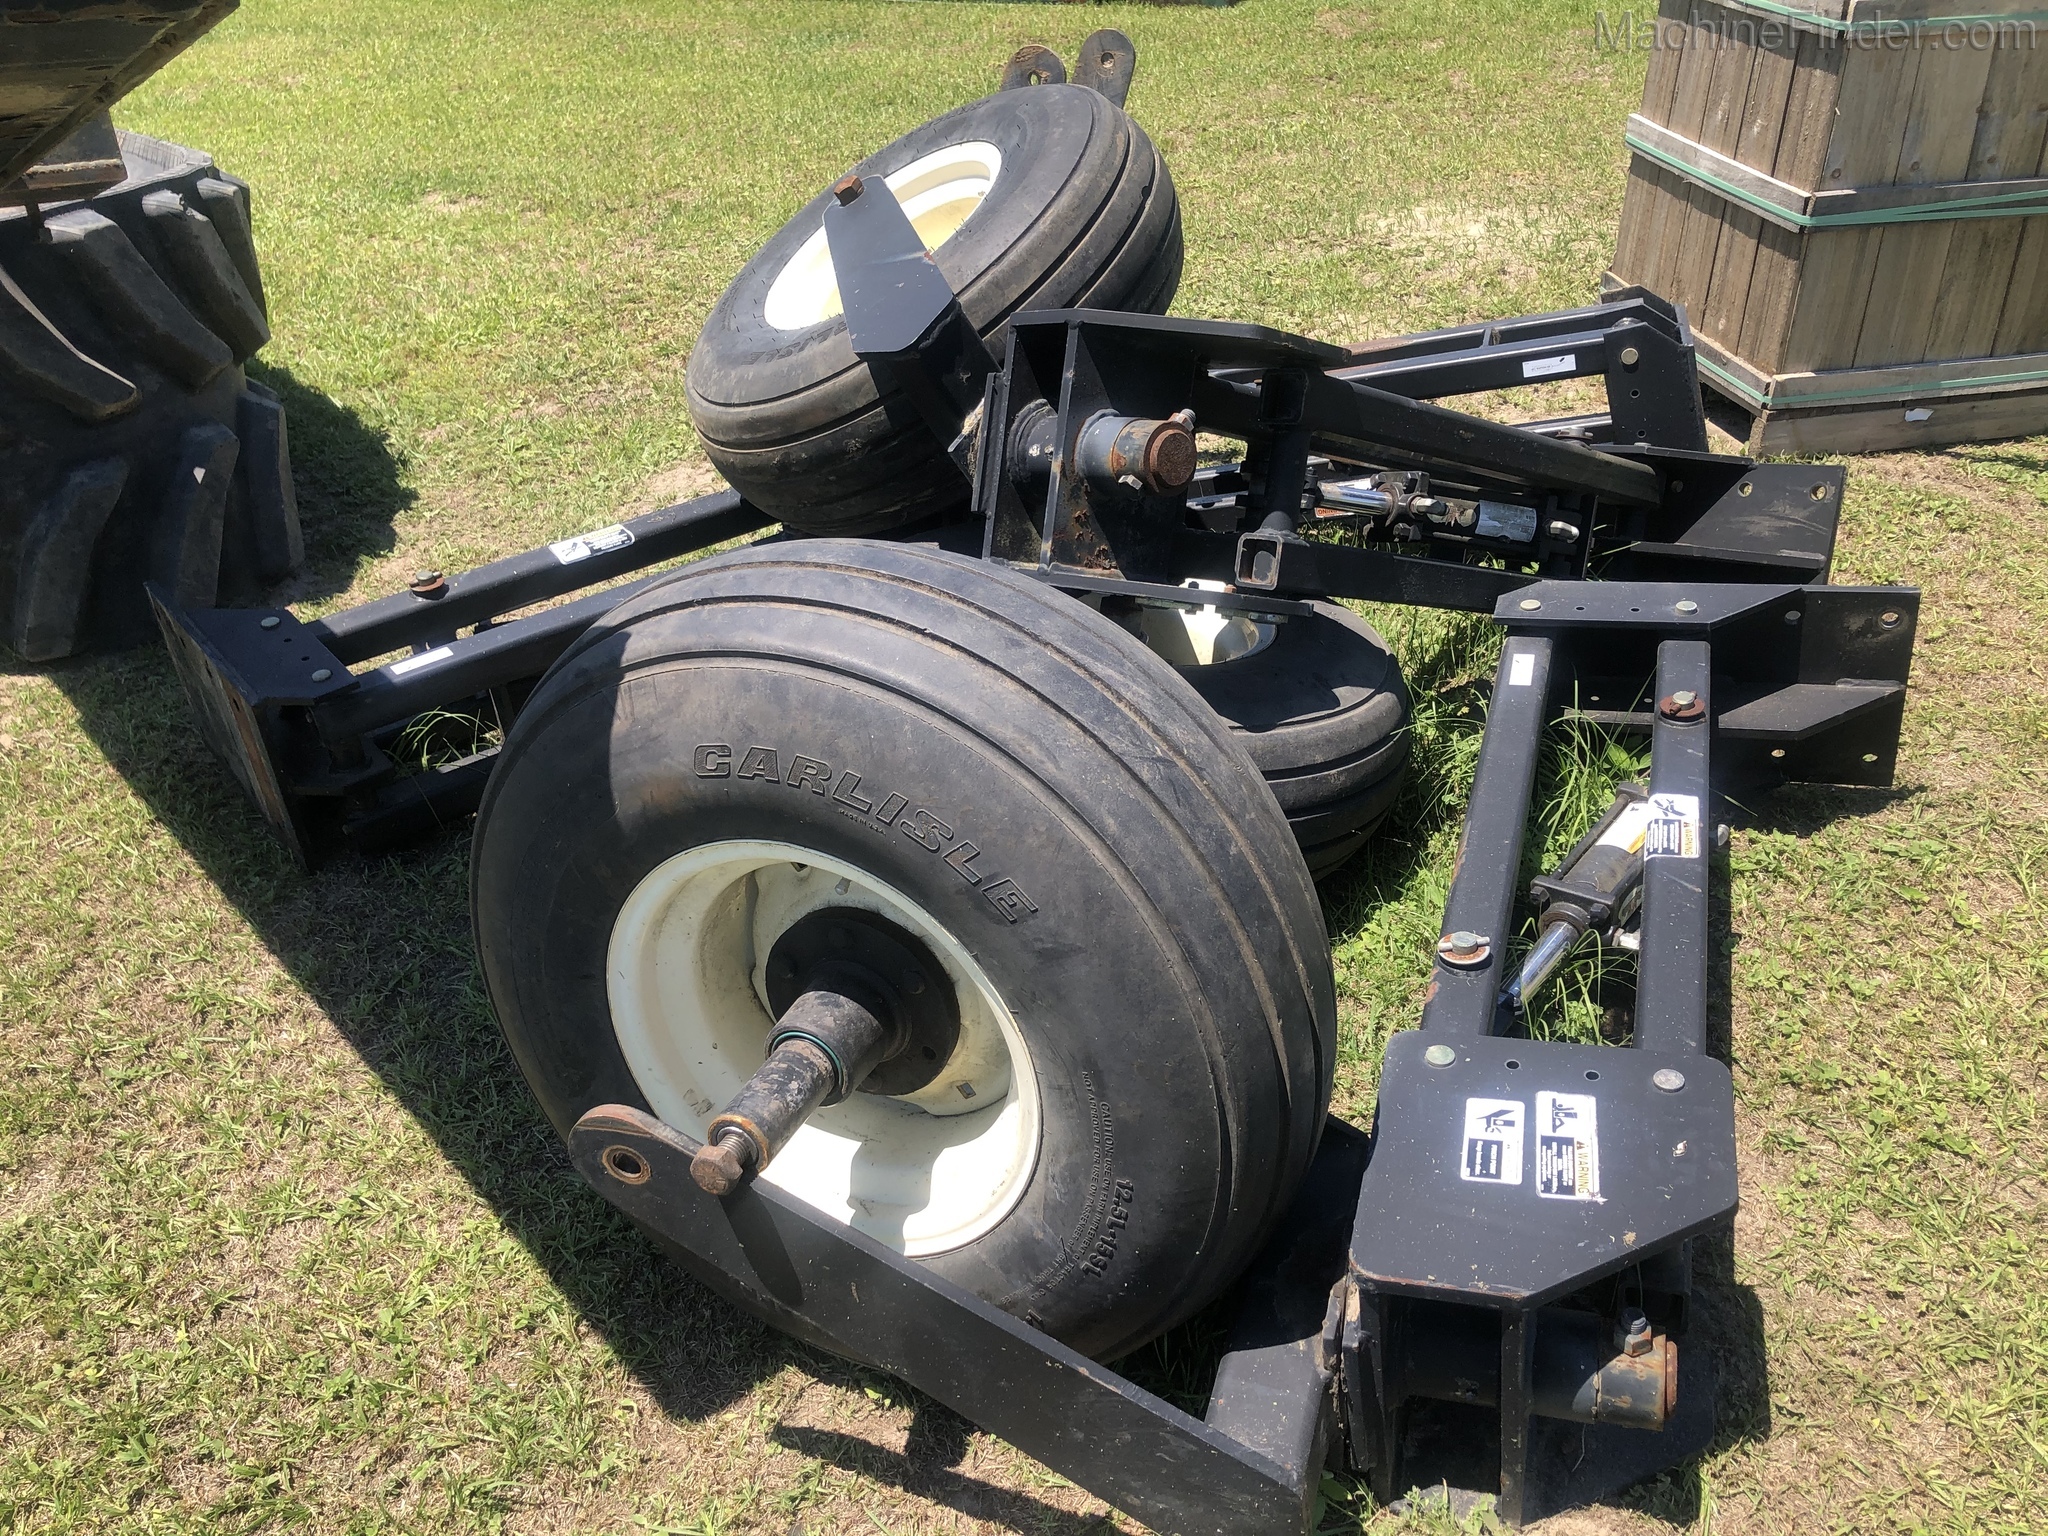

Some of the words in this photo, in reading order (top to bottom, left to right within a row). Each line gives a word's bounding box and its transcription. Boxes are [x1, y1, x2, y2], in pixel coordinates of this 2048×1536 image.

[693, 743, 1039, 924] CARLISLE
[1082, 1071, 1095, 1093] NOT
[1088, 1093, 1101, 1146] APPROVED
[1100, 1101, 1114, 1158] CAUTION:
[1093, 1145, 1101, 1164] FOR
[1104, 1157, 1112, 1176] USE
[1089, 1183, 1097, 1196] ON
[1091, 1164, 1100, 1183] USE
[1101, 1177, 1111, 1191] ON
[1578, 1152, 1590, 1194] WARNING
[1072, 1195, 1094, 1241] PASSENGER
[1096, 1190, 1108, 1214] FARM
[1079, 1213, 1102, 1255] IMPLEMENT
[1080, 1179, 1134, 1278] 12.5L-15SL
